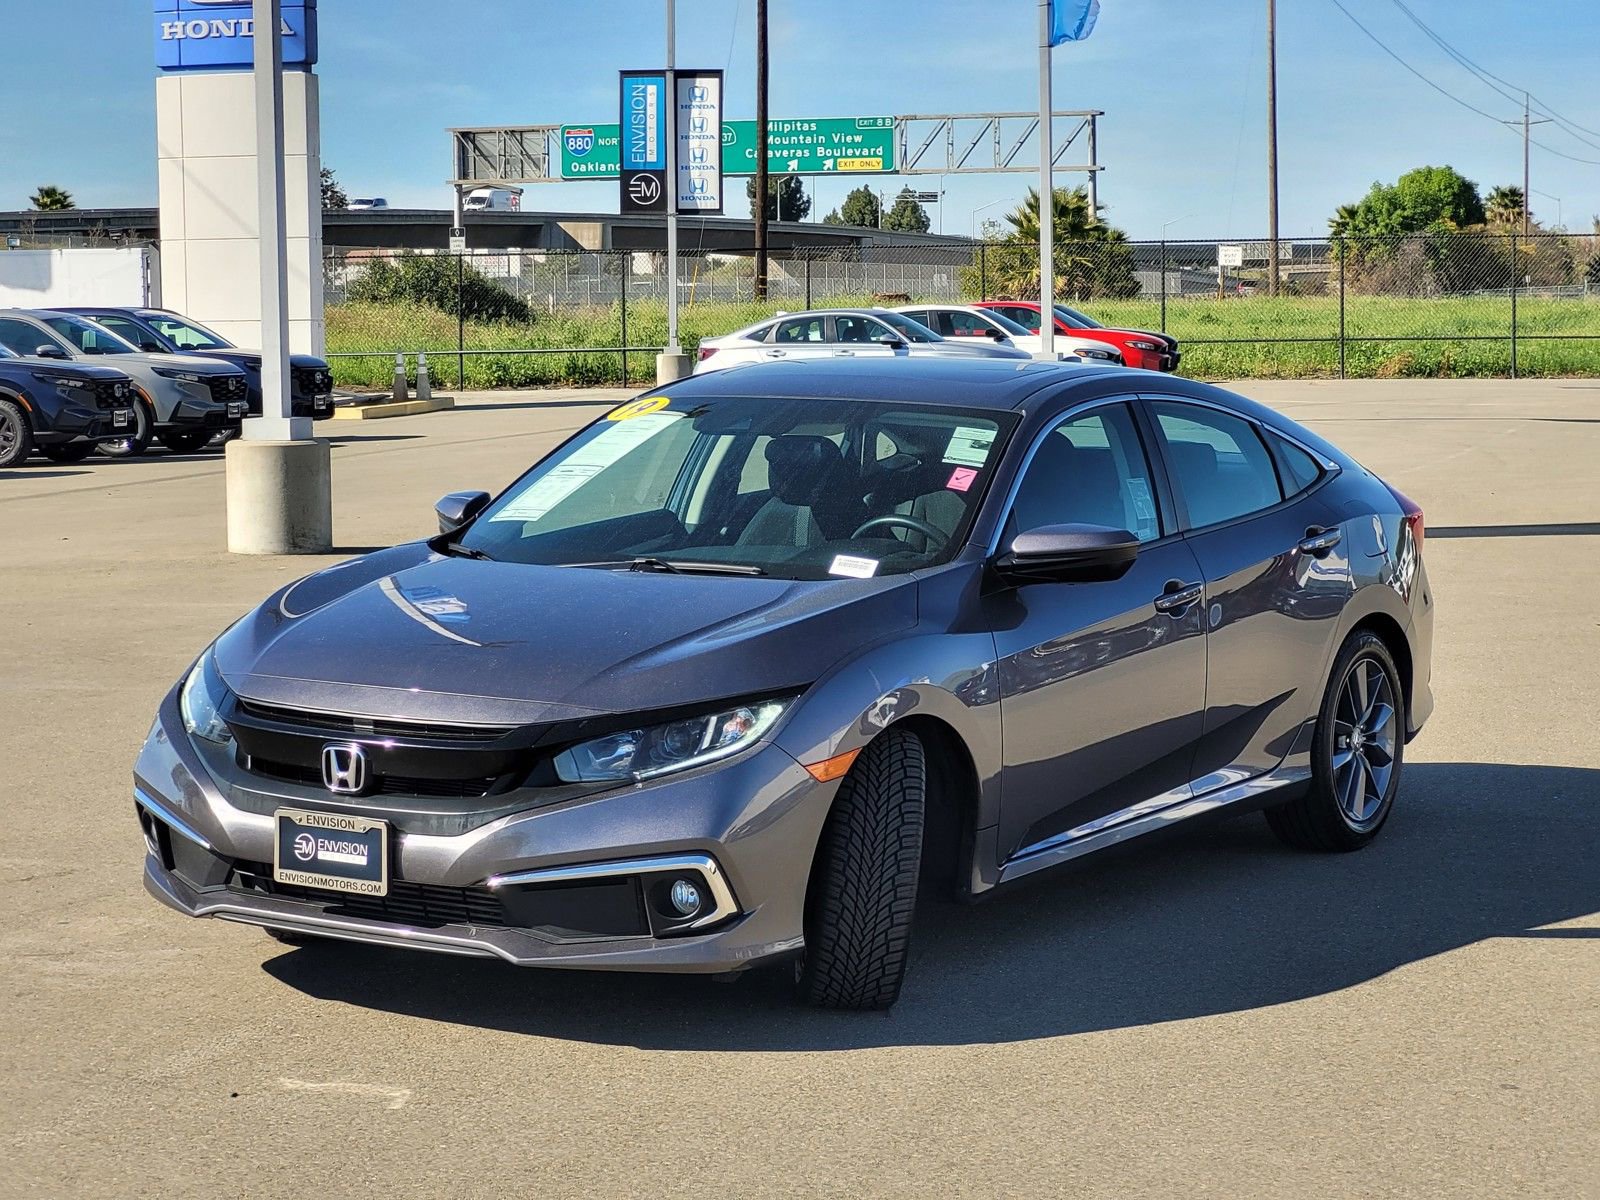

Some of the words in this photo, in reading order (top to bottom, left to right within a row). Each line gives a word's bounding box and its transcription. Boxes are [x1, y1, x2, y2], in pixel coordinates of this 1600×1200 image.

[631, 84, 646, 162] ENVISION
[767, 121, 817, 133] Milpitas
[568, 137, 591, 150] 880
[598, 137, 620, 146] NOR
[767, 133, 826, 145] Mountain
[832, 133, 863, 144] View
[745, 148, 810, 158] Caaveras
[816, 145, 883, 157] Boulevard
[838, 160, 855, 168] EXIT
[859, 160, 881, 168] ONLY
[306, 814, 355, 830] ENVISION
[317, 838, 368, 856] ENVISION
[279, 871, 382, 894] ENVISIONMOTORS.COM
